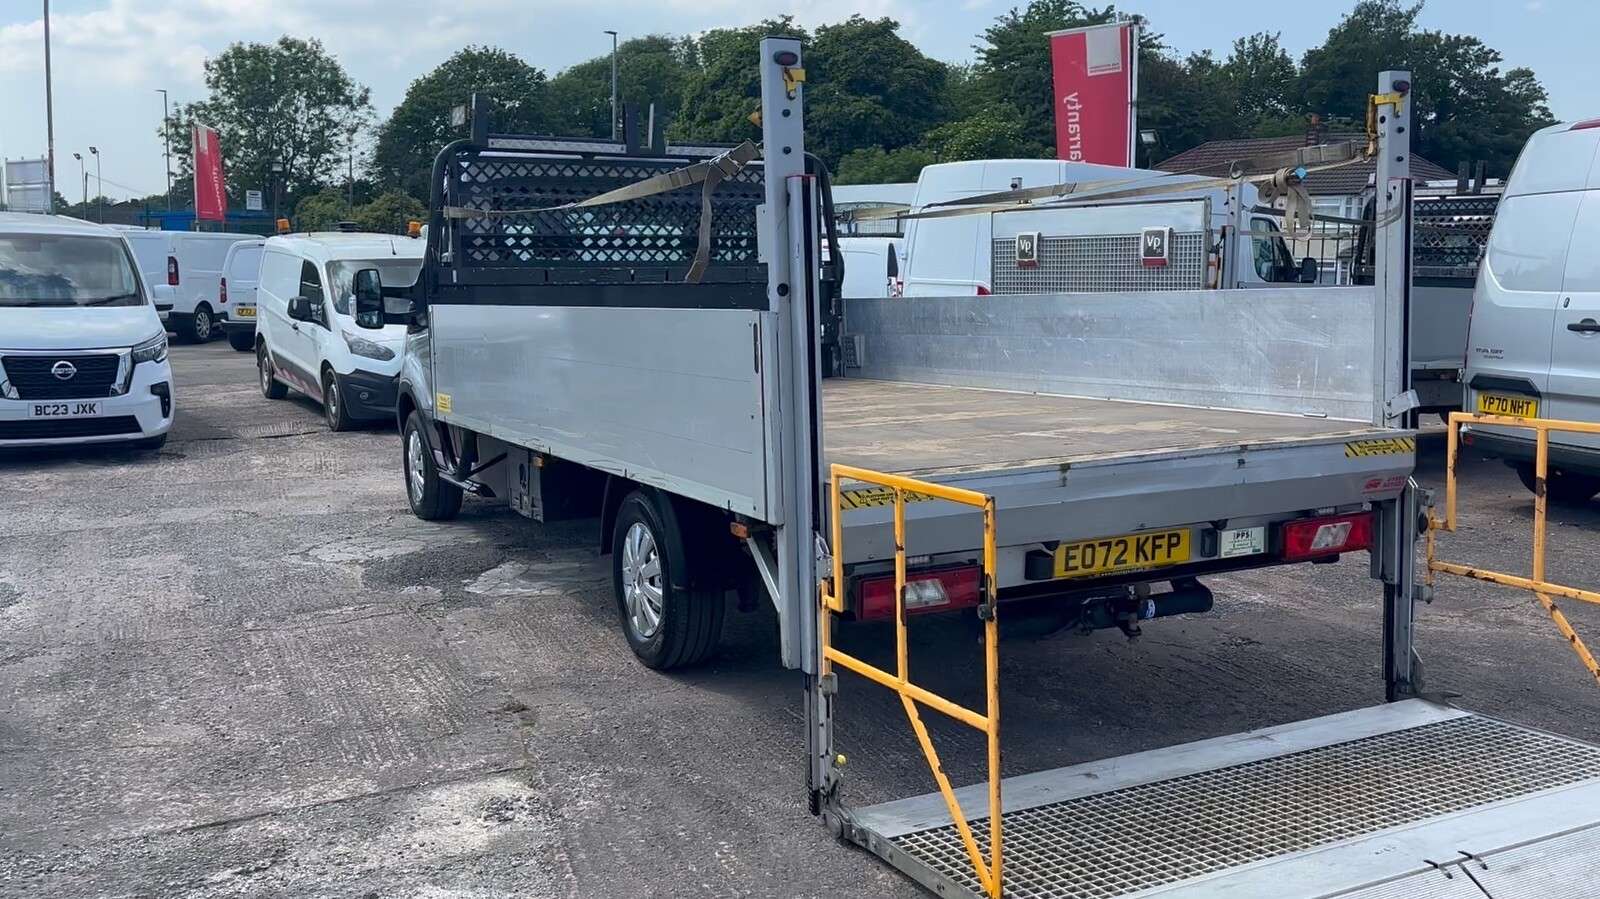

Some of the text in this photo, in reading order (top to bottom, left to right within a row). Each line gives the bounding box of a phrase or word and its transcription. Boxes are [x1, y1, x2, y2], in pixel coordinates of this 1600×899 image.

[34, 403, 97, 416] BC23 JXK
[1482, 395, 1532, 416] YP70 NHT
[1064, 532, 1181, 572] EO72 KFP
